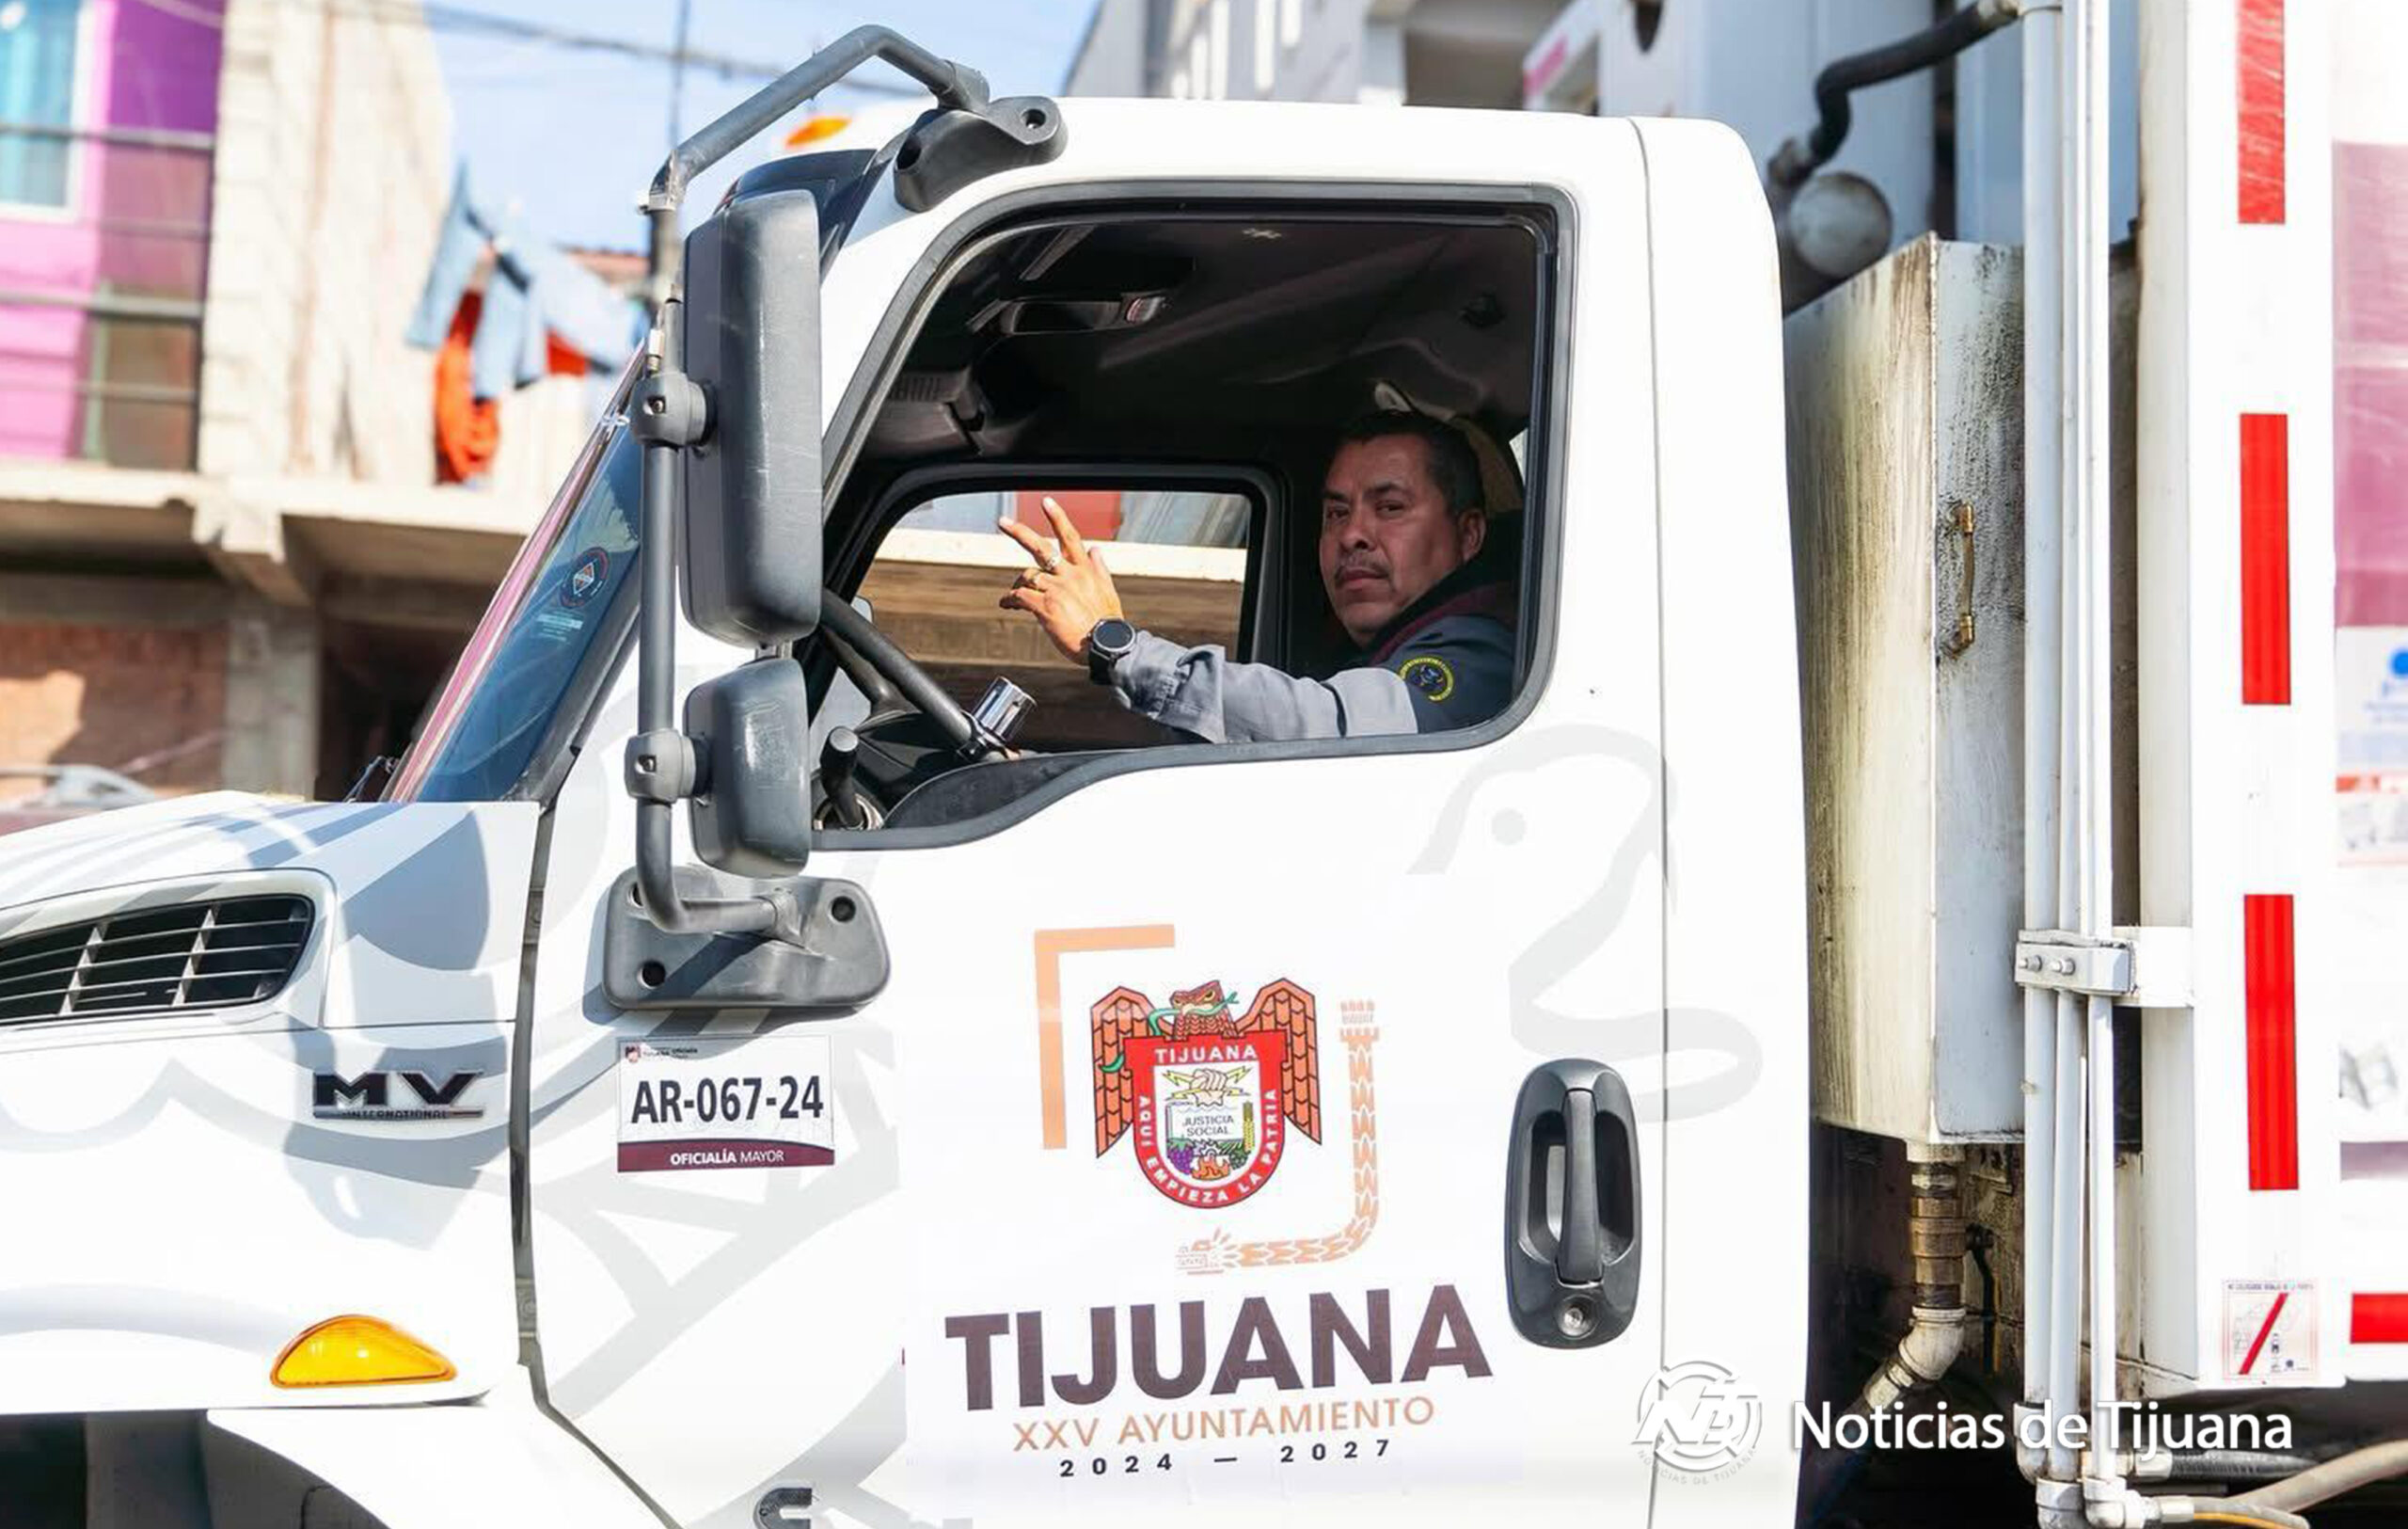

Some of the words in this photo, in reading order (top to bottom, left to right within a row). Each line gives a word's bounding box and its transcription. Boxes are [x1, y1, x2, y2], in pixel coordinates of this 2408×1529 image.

[1155, 1043, 1258, 1064] TIJUANA
[313, 1071, 483, 1107] MV
[630, 1075, 824, 1123] AR-067-24
[347, 1108, 448, 1121] INTERNATIONAL
[1182, 1115, 1234, 1127] JUSTICIA
[1186, 1126, 1228, 1137] SOCIAL
[670, 1148, 737, 1166] OFICIALÍA
[739, 1149, 784, 1163] MAYOR
[1138, 1095, 1152, 1147] AQUI
[1147, 1156, 1229, 1203] EMPIEZA
[1237, 1172, 1262, 1194] LA
[1260, 1089, 1278, 1165] PATRIA
[944, 1284, 1494, 1410] TIJUANA
[1013, 1417, 1101, 1451] XXV
[1117, 1396, 1435, 1445] AYUNTAMIENTO
